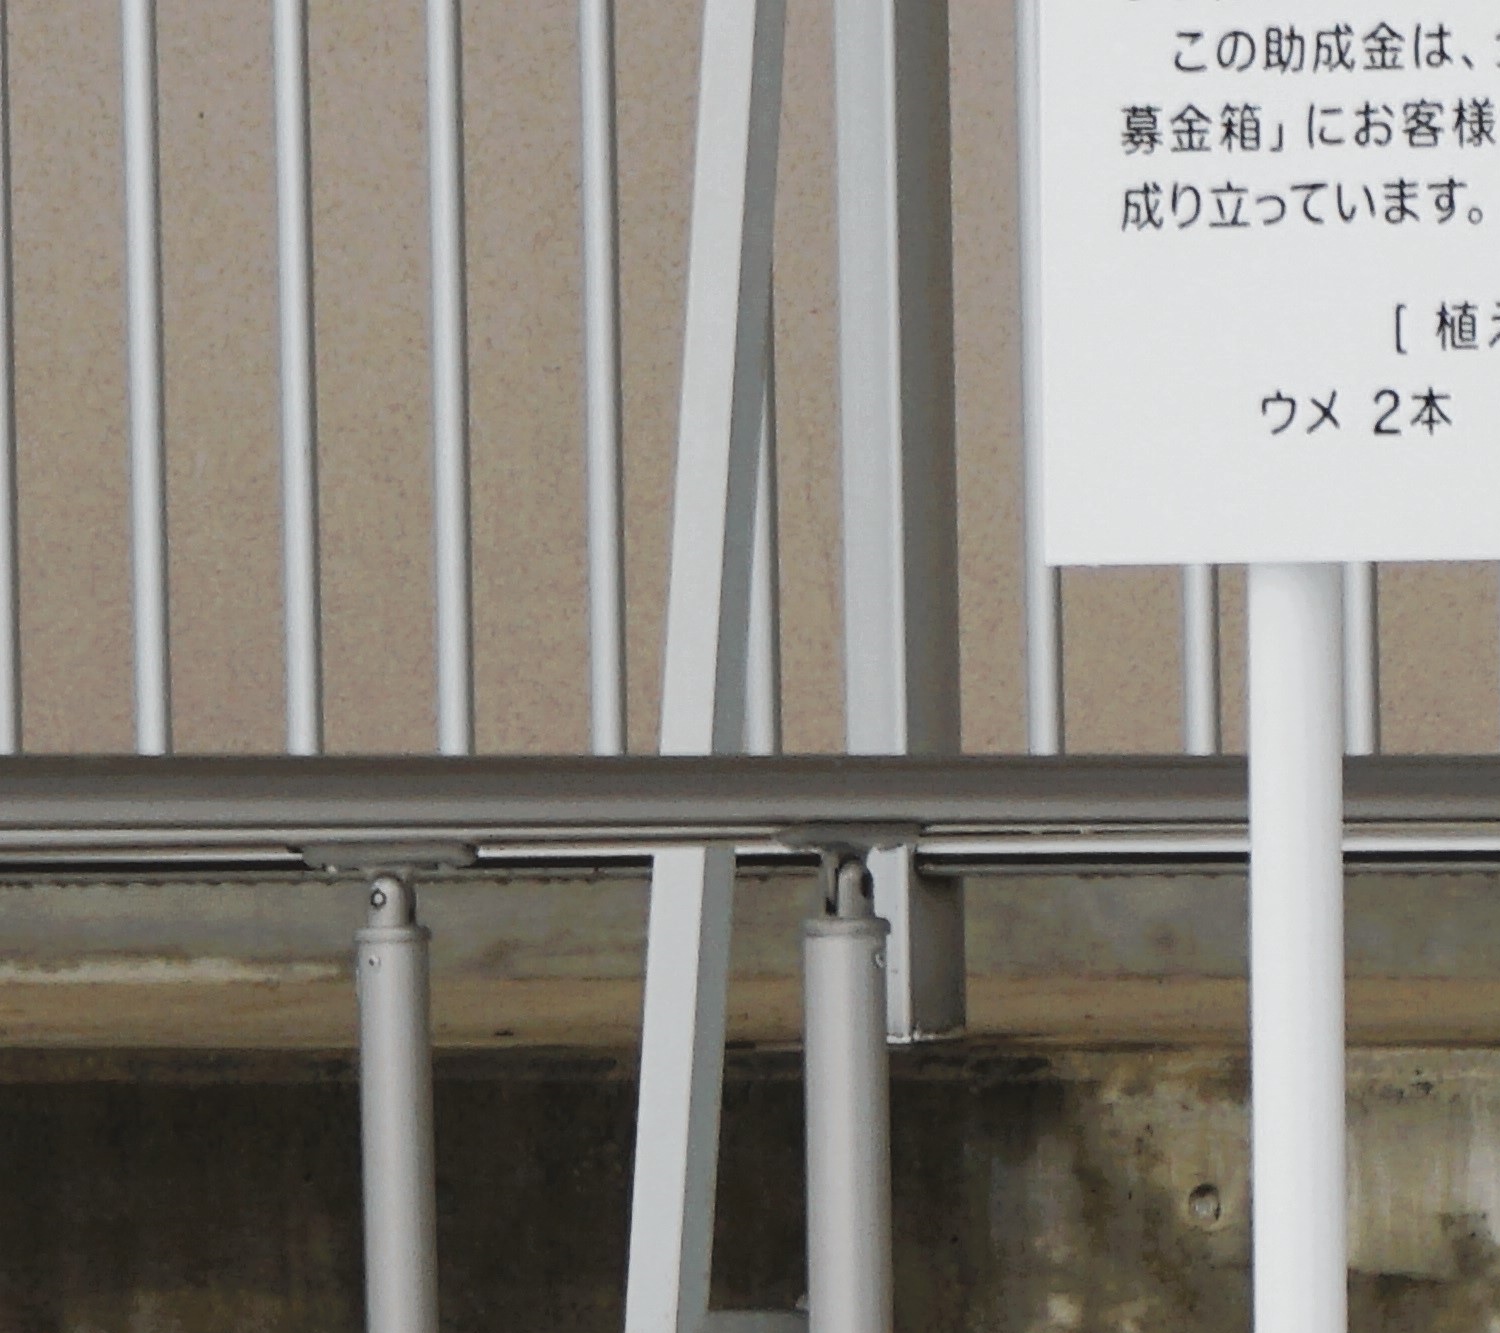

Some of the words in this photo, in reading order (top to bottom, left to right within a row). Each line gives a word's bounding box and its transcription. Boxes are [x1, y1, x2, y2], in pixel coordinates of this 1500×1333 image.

[1121, 177, 1484, 231] 成り立っています。
[1260, 389, 1340, 434] ウメ
[1372, 386, 1452, 435] 2本
